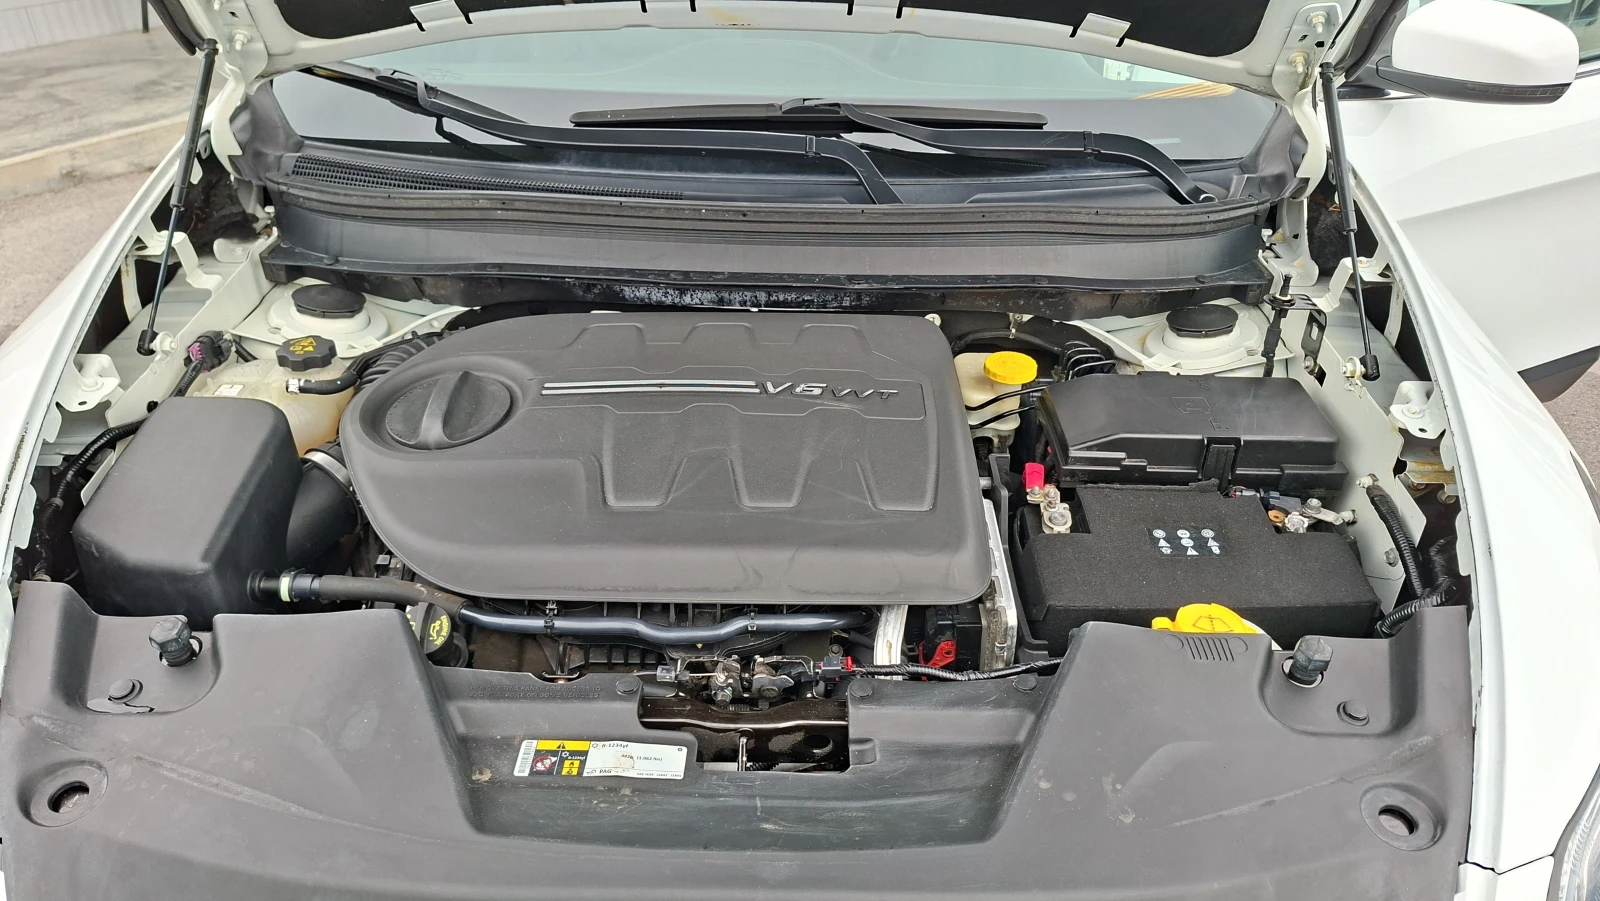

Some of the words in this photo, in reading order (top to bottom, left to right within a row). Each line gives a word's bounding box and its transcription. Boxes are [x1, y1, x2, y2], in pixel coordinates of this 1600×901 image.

[762, 381, 827, 396] V6
[832, 388, 899, 399] VVT
[440, 615, 448, 636] ENGINE
[434, 637, 444, 645] OIL
